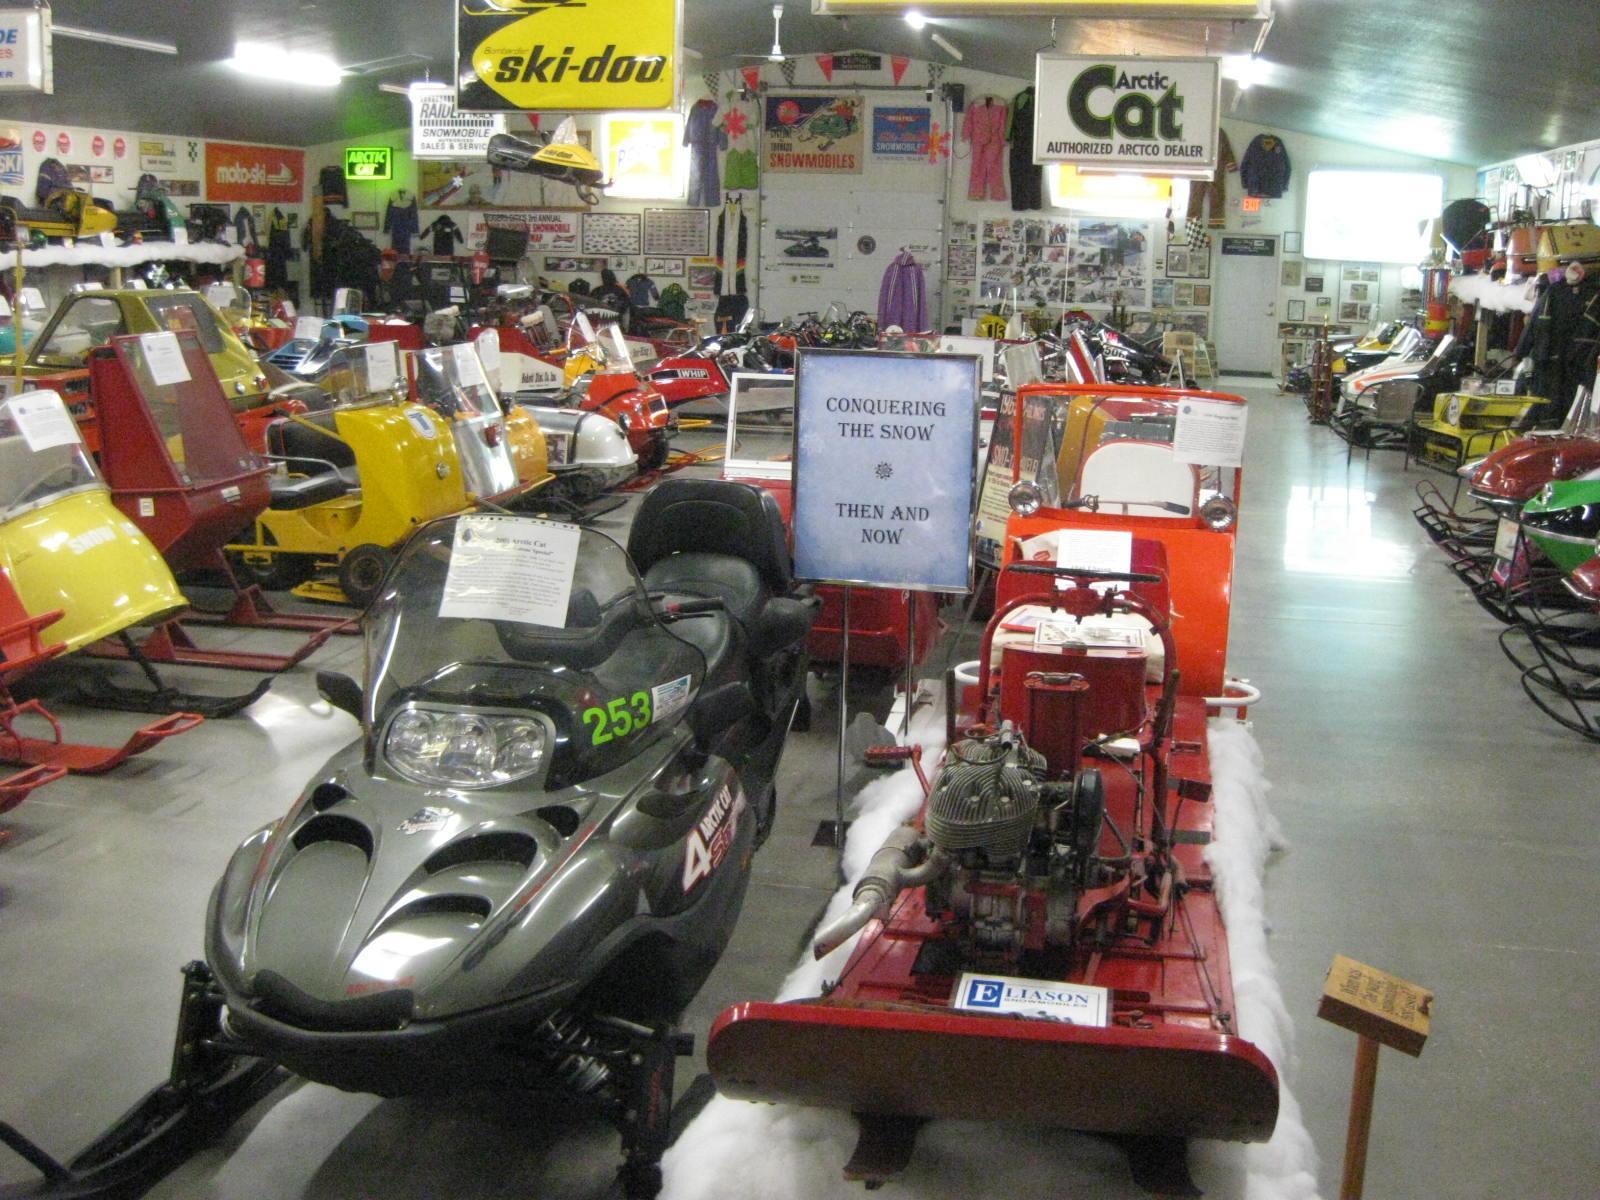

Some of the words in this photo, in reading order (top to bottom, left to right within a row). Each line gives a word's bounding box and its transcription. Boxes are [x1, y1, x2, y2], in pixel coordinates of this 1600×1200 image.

[495, 45, 666, 83] ski-doo
[1115, 71, 1169, 90] Arctic
[1067, 64, 1184, 141] Cat
[422, 128, 490, 138] SNOWMOBILE
[420, 142, 446, 150] SALES
[462, 143, 487, 151] SERVIC
[1047, 141, 1113, 155] AUTHORIZED
[1118, 144, 1160, 156] ARCTCO
[1164, 145, 1204, 157] DEALER
[349, 152, 387, 163] ARCTIC
[769, 152, 856, 169] SNOWMOBILES
[681, 369, 706, 378] WHIP
[826, 397, 946, 417] CONQUERING
[838, 422, 874, 438] THE
[880, 424, 935, 441] SNOW
[835, 503, 884, 519] THEN
[890, 506, 929, 522] AND
[861, 528, 904, 545] NOW
[582, 690, 652, 746] 253
